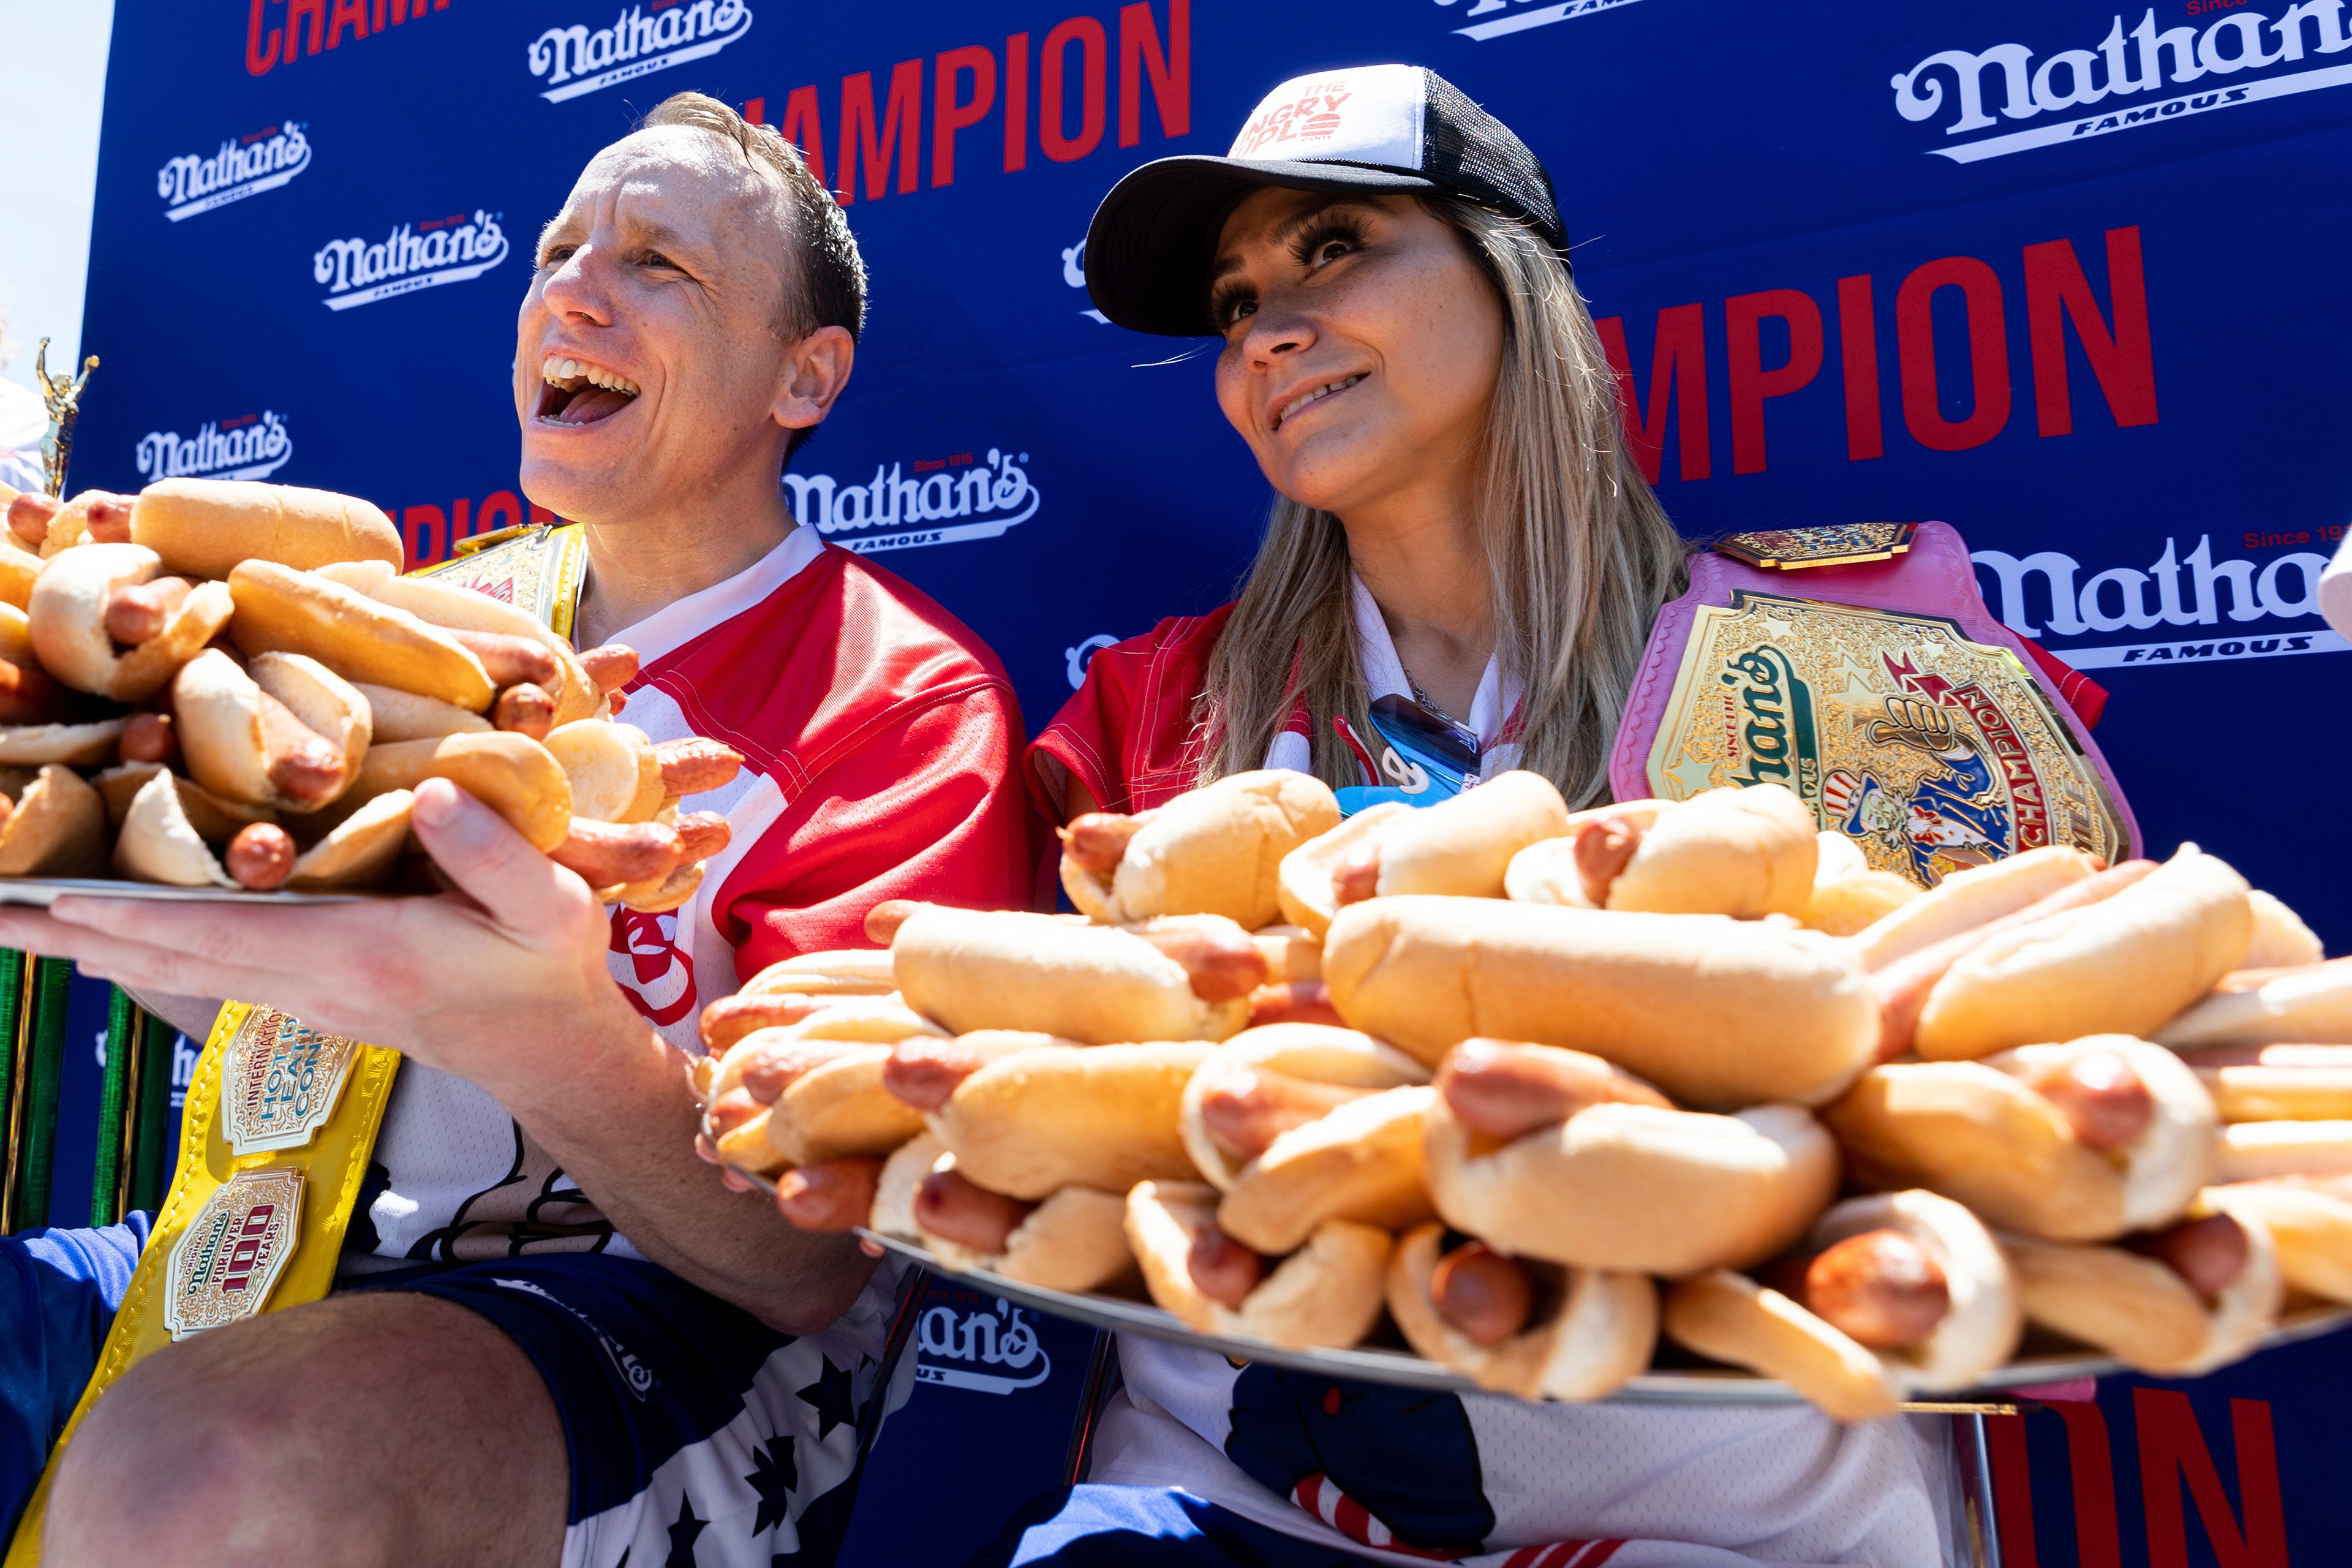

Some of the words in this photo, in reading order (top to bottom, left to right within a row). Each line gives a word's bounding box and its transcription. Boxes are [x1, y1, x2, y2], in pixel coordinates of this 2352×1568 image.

[528, 0, 745, 85] Nathans
[1891, 0, 2352, 135] Nathan
[743, 0, 1190, 207] AMPION
[1305, 80, 1348, 97] THE
[2071, 88, 2250, 136] FAMOUS
[157, 120, 307, 206] Nathan's
[314, 209, 503, 293] Nathan's
[136, 409, 287, 483] Nathan's
[914, 461, 946, 473] Since
[949, 452, 974, 466] 1916
[782, 448, 1030, 534] Nathan's
[852, 532, 943, 551] FAMOUS
[2244, 532, 2310, 549] Since
[2316, 524, 2352, 542] 19
[2122, 636, 2313, 662] FAMOUS
[1960, 690, 2046, 848] CHAMPION
[247, 1011, 282, 1107] INTERNATIO
[261, 1050, 288, 1120] HOT
[280, 1025, 311, 1102] EATI
[185, 1231, 206, 1276] ORIGINAL
[187, 1212, 227, 1296] Nathan's
[211, 1257, 230, 1283] FOR
[221, 1217, 244, 1253] OVER
[222, 1204, 275, 1294] 100
[254, 1223, 280, 1270] YEARS
[916, 1297, 1039, 1369] an's
